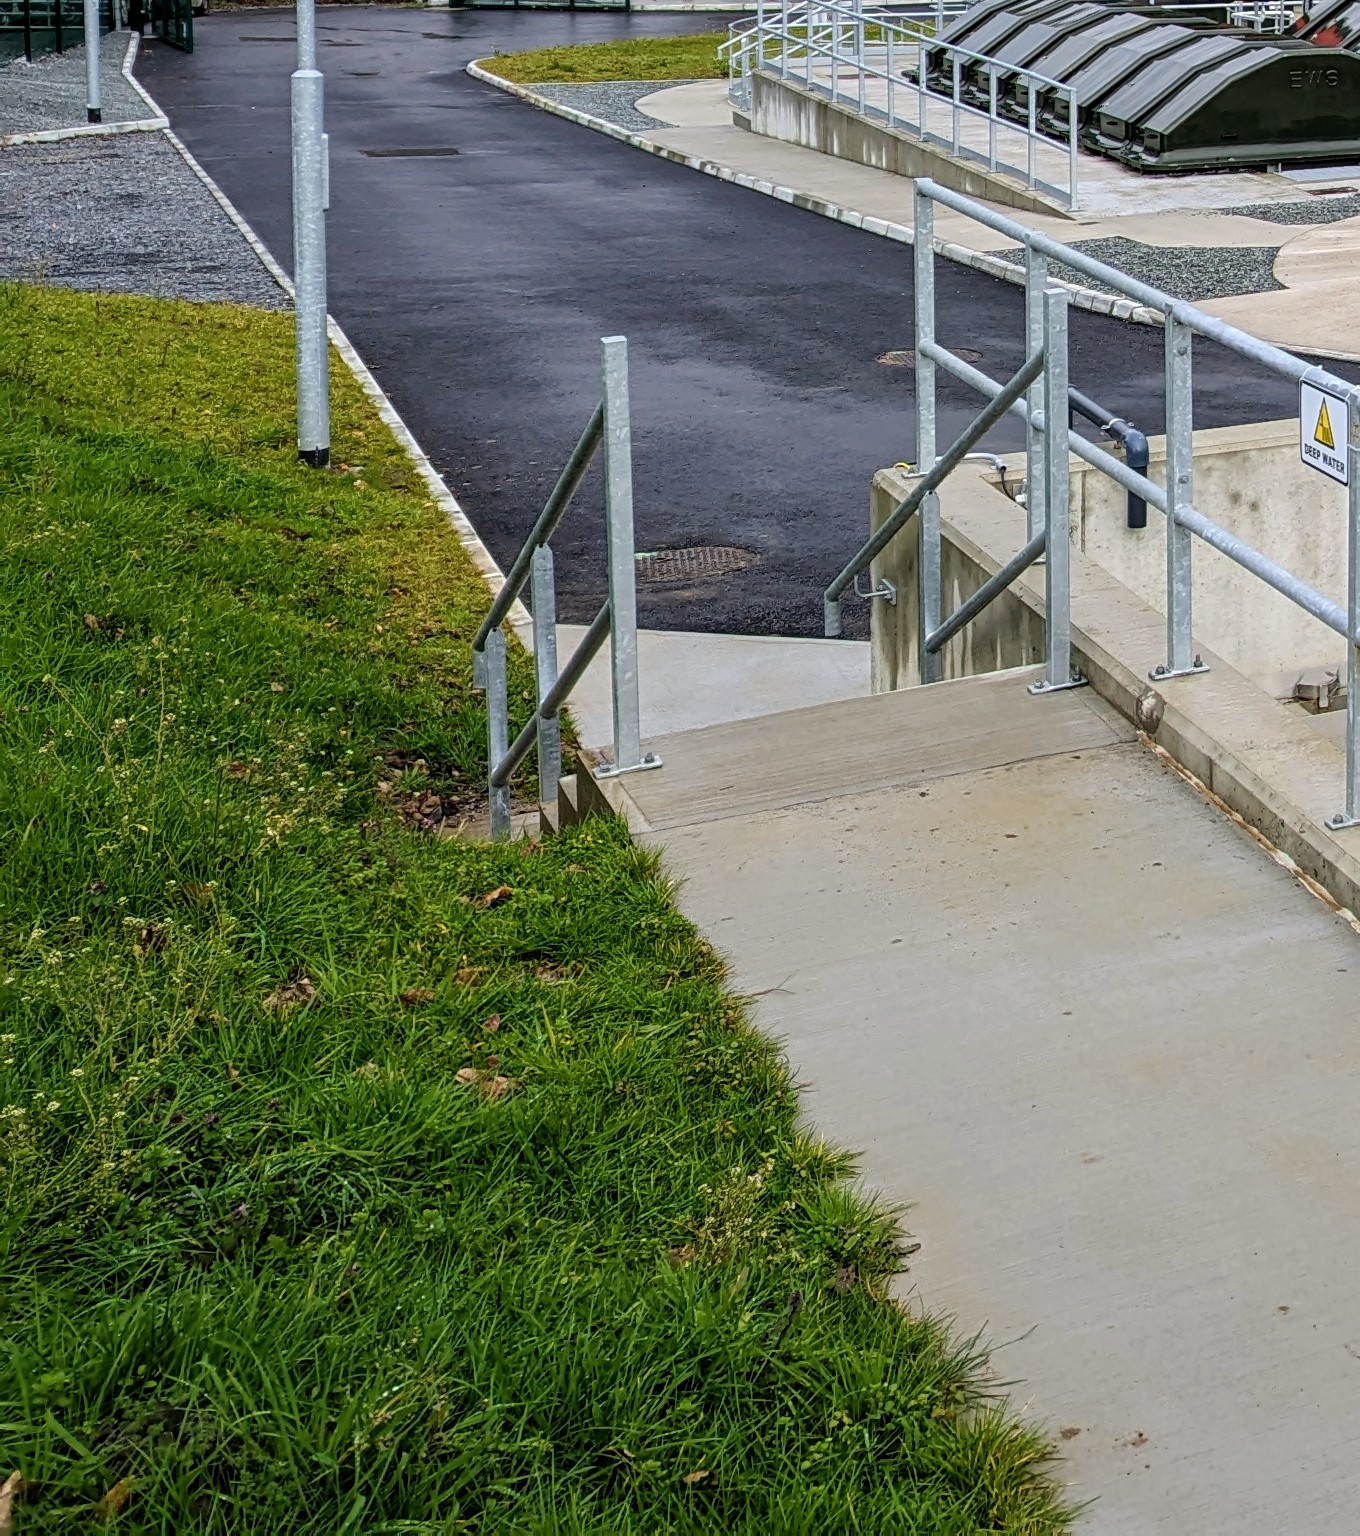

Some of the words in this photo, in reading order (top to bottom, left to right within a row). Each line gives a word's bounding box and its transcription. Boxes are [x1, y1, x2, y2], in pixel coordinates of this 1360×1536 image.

[1289, 69, 1338, 88] EWS
[1304, 443, 1321, 460] DEEP
[1322, 452, 1345, 474] WATER
